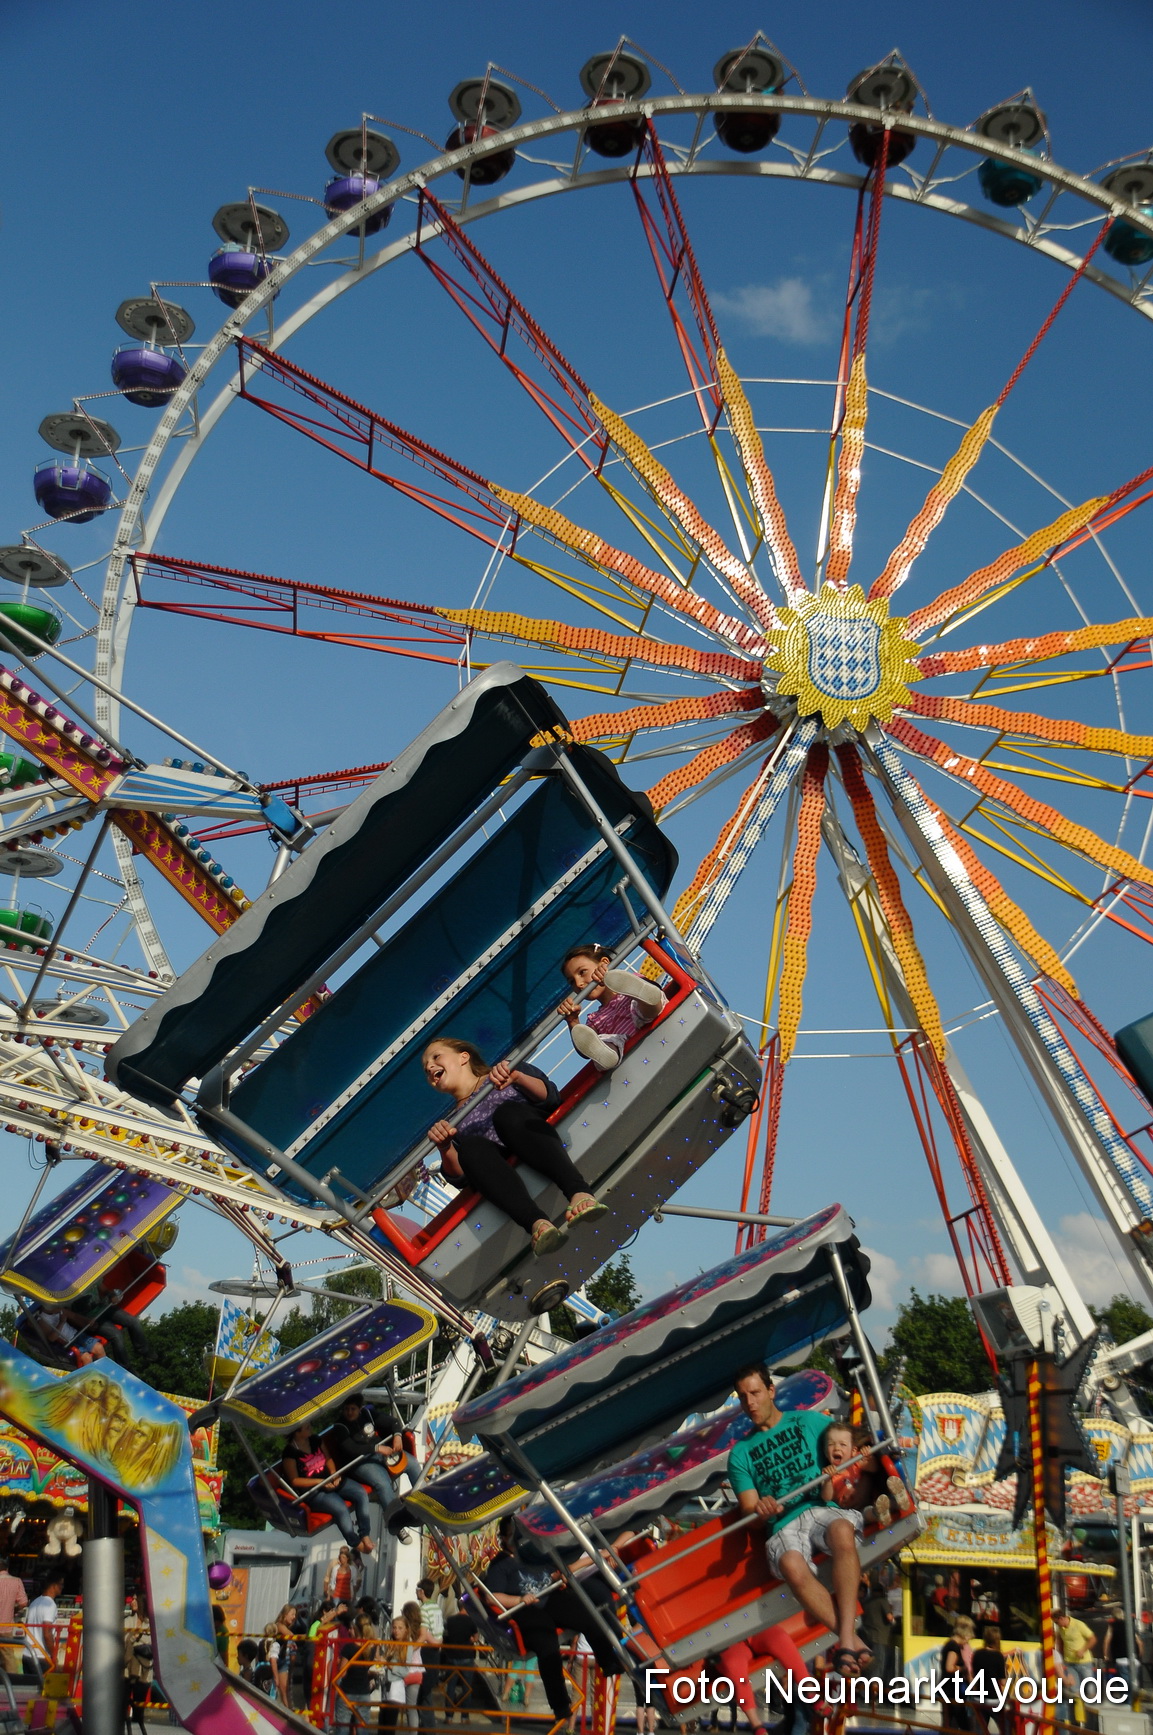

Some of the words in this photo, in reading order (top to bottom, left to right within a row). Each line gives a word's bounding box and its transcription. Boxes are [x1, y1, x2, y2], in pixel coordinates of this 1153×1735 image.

[748, 1426, 796, 1461] MIAMI
[753, 1440, 804, 1477] BEACH
[771, 1452, 815, 1482] GIRLZ
[946, 1528, 1010, 1546] KASSE
